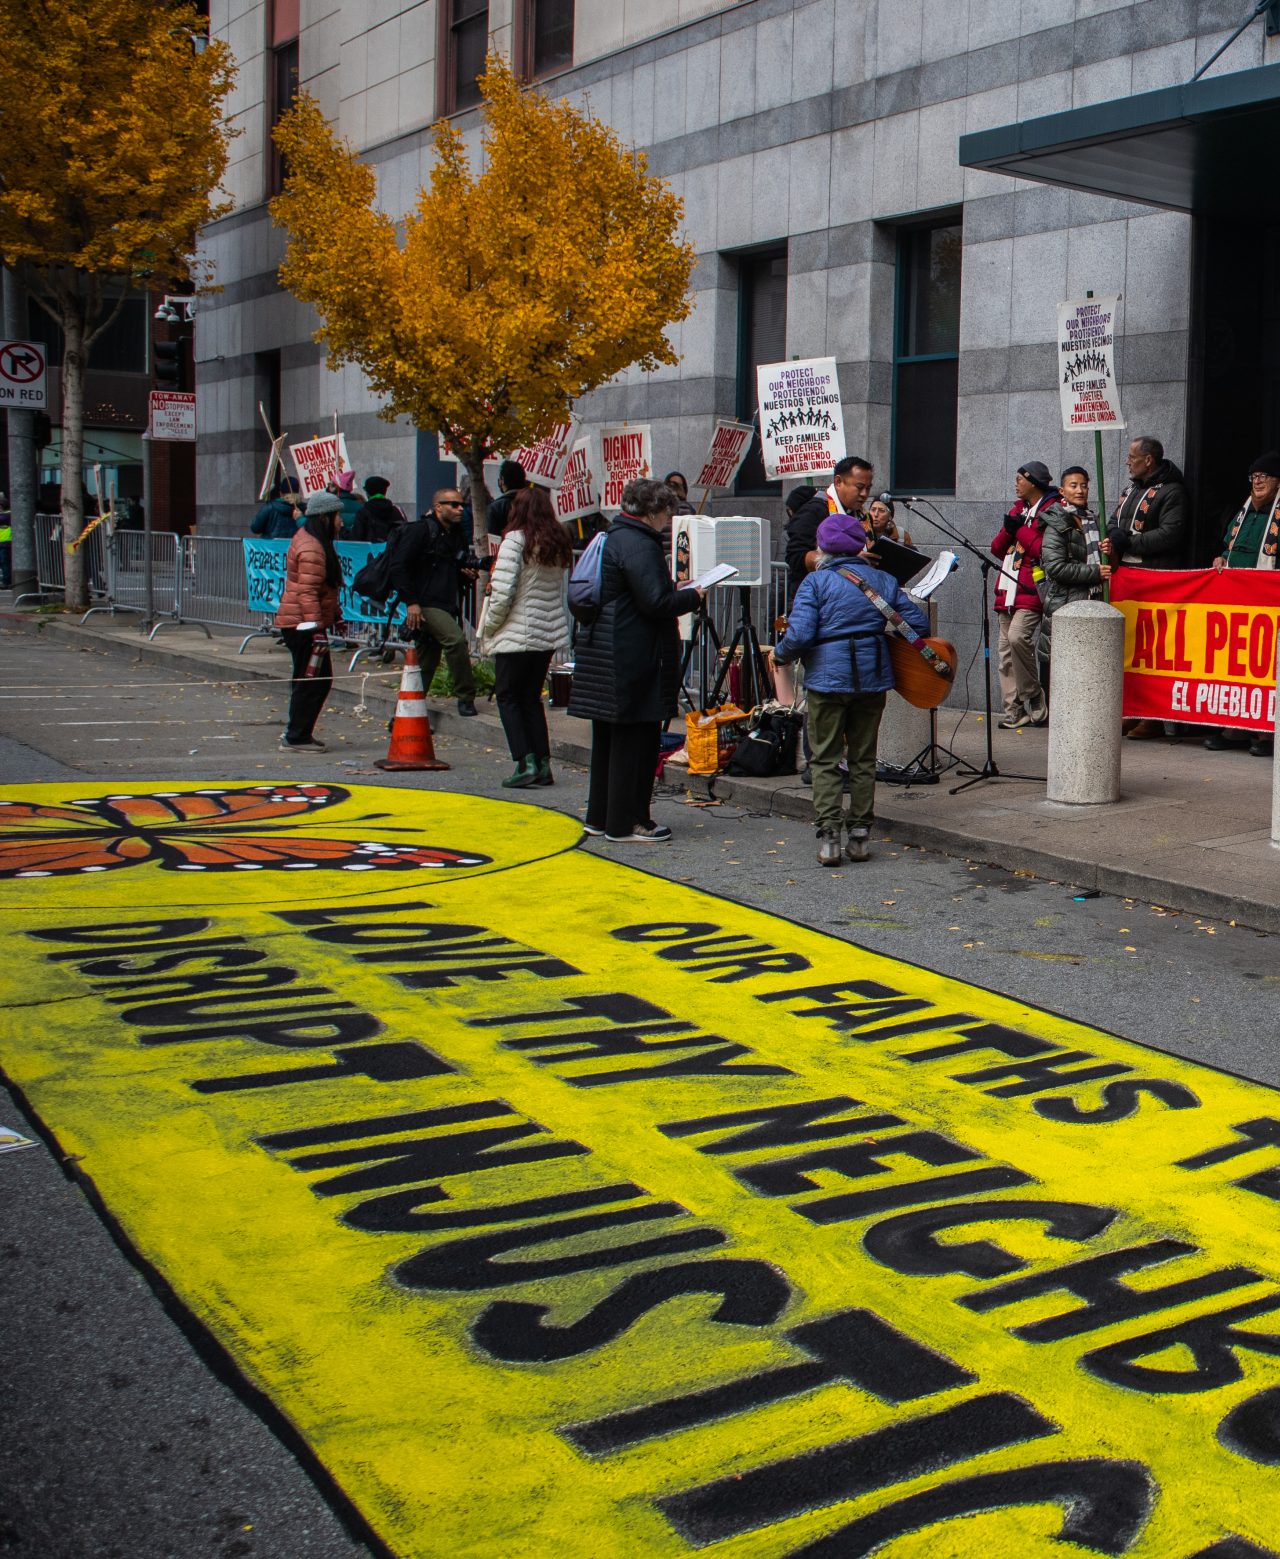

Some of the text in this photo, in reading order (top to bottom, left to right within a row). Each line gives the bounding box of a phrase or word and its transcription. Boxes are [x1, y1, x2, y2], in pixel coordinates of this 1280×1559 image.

[1076, 304, 1101, 317] PROTECT
[1066, 313, 1111, 330] OUR NEIGHBORS
[781, 368, 814, 380] PROTECT
[769, 375, 831, 391] OUR NEIGHBORS
[0, 388, 43, 401] ON RED
[154, 393, 193, 402] TOW-AWAY
[773, 386, 826, 400] PROTEGIENDO
[153, 400, 194, 411] NO STOPPING
[764, 394, 839, 411] NUESTROS VECINOS
[1070, 411, 1117, 424] FAMILIAS UNIDAS
[603, 433, 643, 462] DIGNITY
[712, 427, 748, 451] DIGNITY
[775, 432, 830, 446] KEEP FAMILIES
[294, 440, 337, 465] DIGNITY
[784, 442, 823, 454] TOGETHER
[516, 448, 540, 473] FOR
[537, 456, 558, 480] ALL
[613, 459, 641, 471] HUMAN
[779, 451, 831, 464] MANTENIENDO
[610, 469, 638, 481] RIGHTS
[696, 464, 734, 486] FOR ALL
[776, 460, 837, 475] FAMILIAS UNIDAS
[304, 473, 326, 493] FOR
[556, 485, 594, 515] FOR ALL
[604, 480, 623, 506] FOR
[1131, 608, 1193, 672] ALL
[1171, 681, 1190, 712] EL
[1196, 683, 1262, 721] PUEBLO
[267, 901, 585, 989] LOVE
[463, 992, 798, 1090] THY
[24, 916, 459, 1094] DISRUPT
[609, 922, 813, 984] OUR
[754, 979, 1202, 1125] FAITHS
